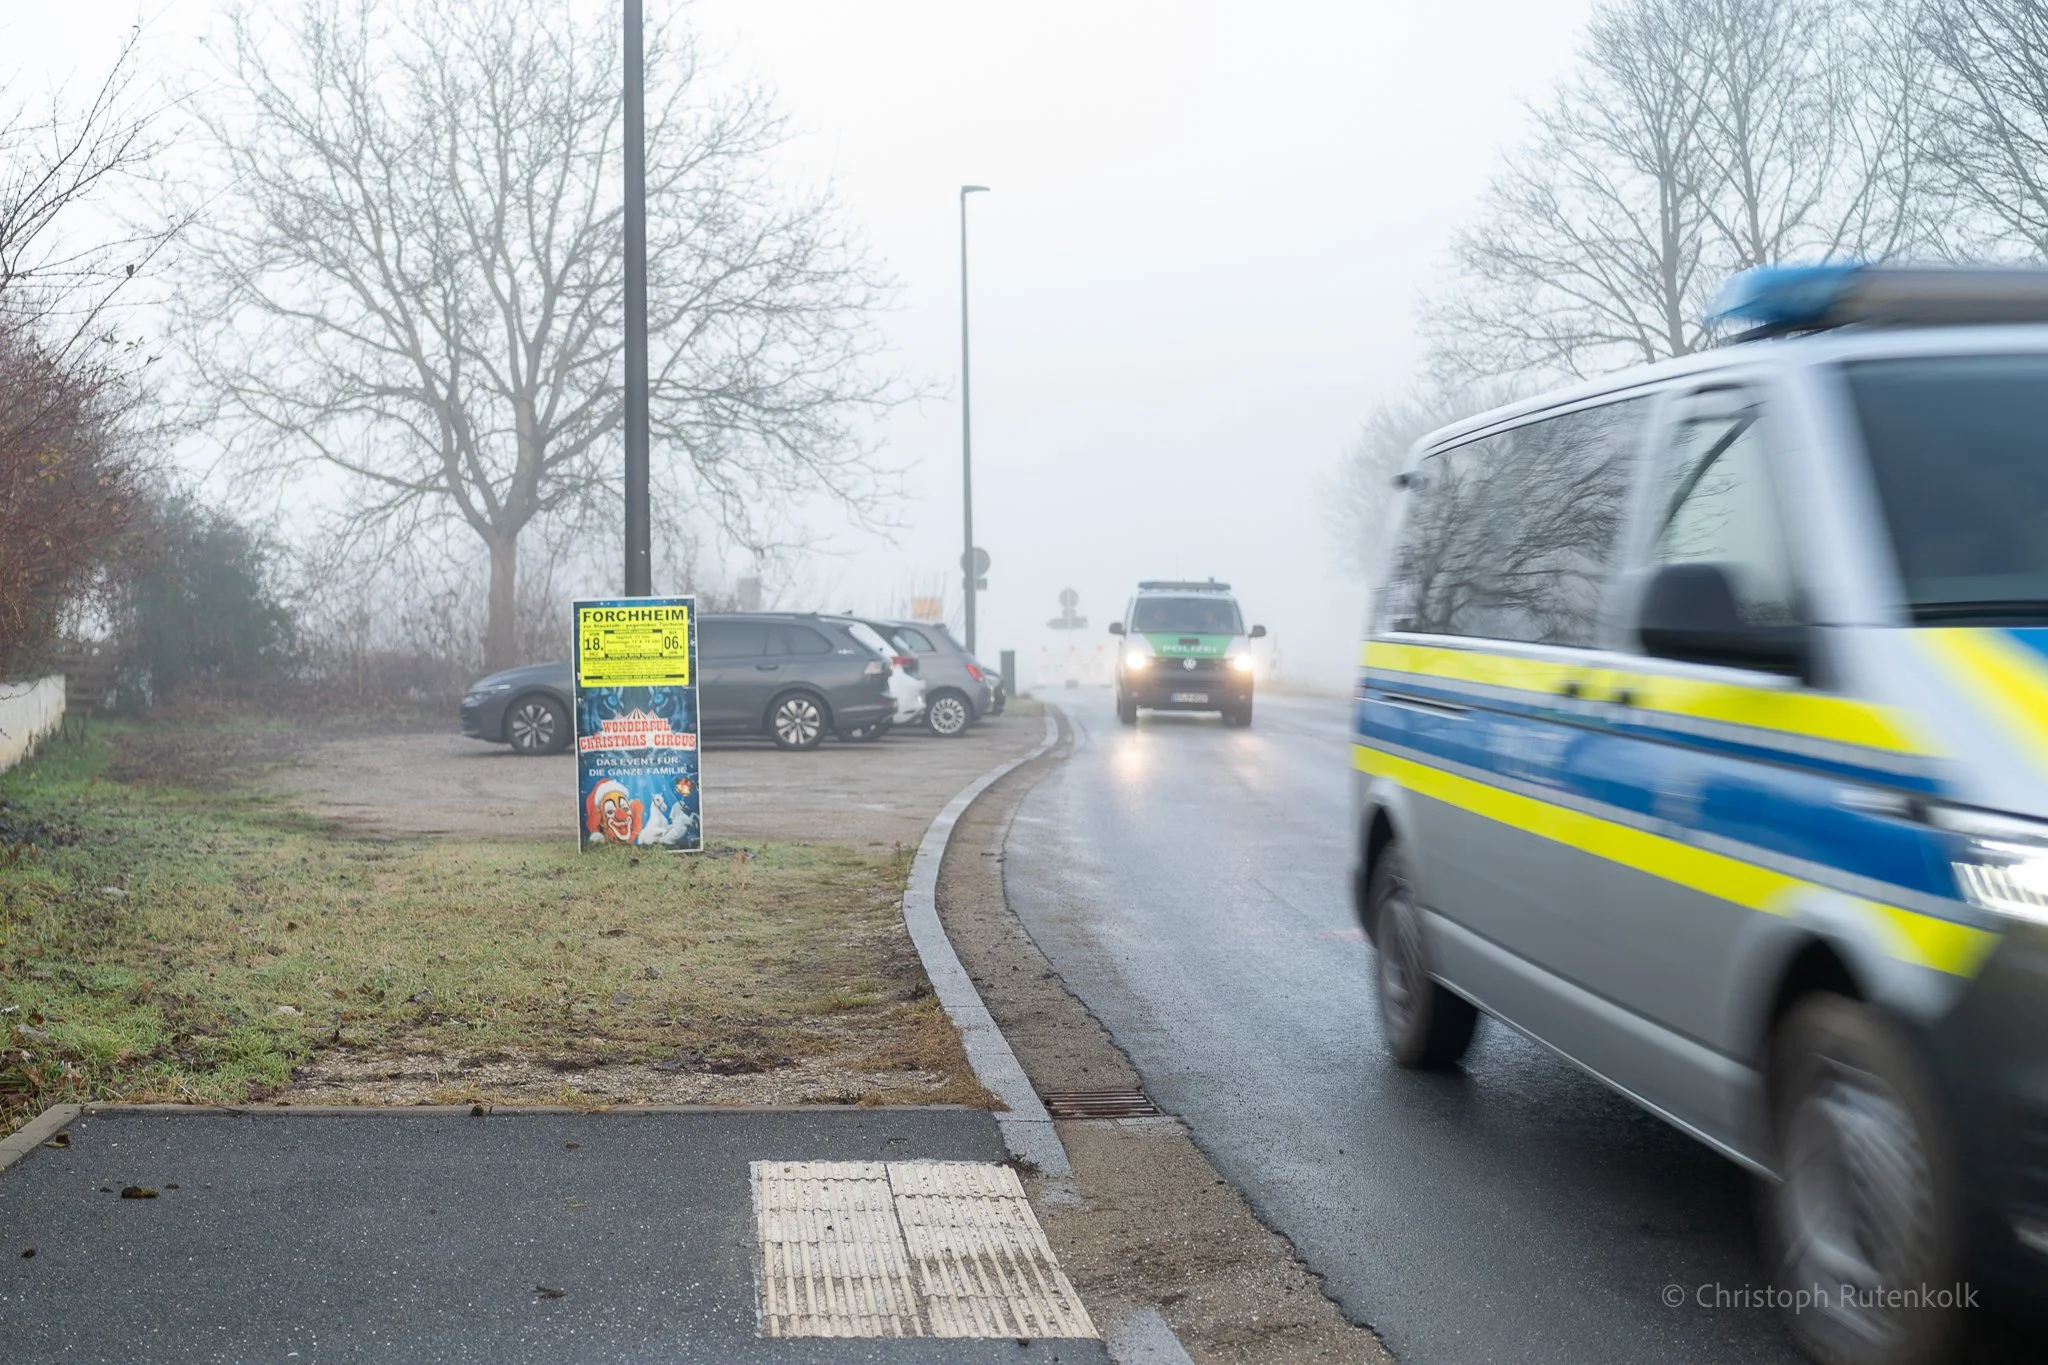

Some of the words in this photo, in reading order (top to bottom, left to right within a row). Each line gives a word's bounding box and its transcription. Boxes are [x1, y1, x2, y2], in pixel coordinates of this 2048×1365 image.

[583, 609, 684, 623] FORCHHEIM
[585, 637, 604, 651] 18.
[664, 635, 683, 650] 06.
[1162, 645, 1217, 653] POLIZEI
[602, 720, 670, 733] WONDERFUL
[654, 733, 696, 748] CIRCUS
[596, 757, 617, 766] DAS
[620, 757, 654, 765] EVENT
[657, 755, 678, 765] FÜR
[589, 769, 605, 777] DIE
[608, 768, 643, 776] GANZE
[646, 766, 687, 776] FAMILIE
